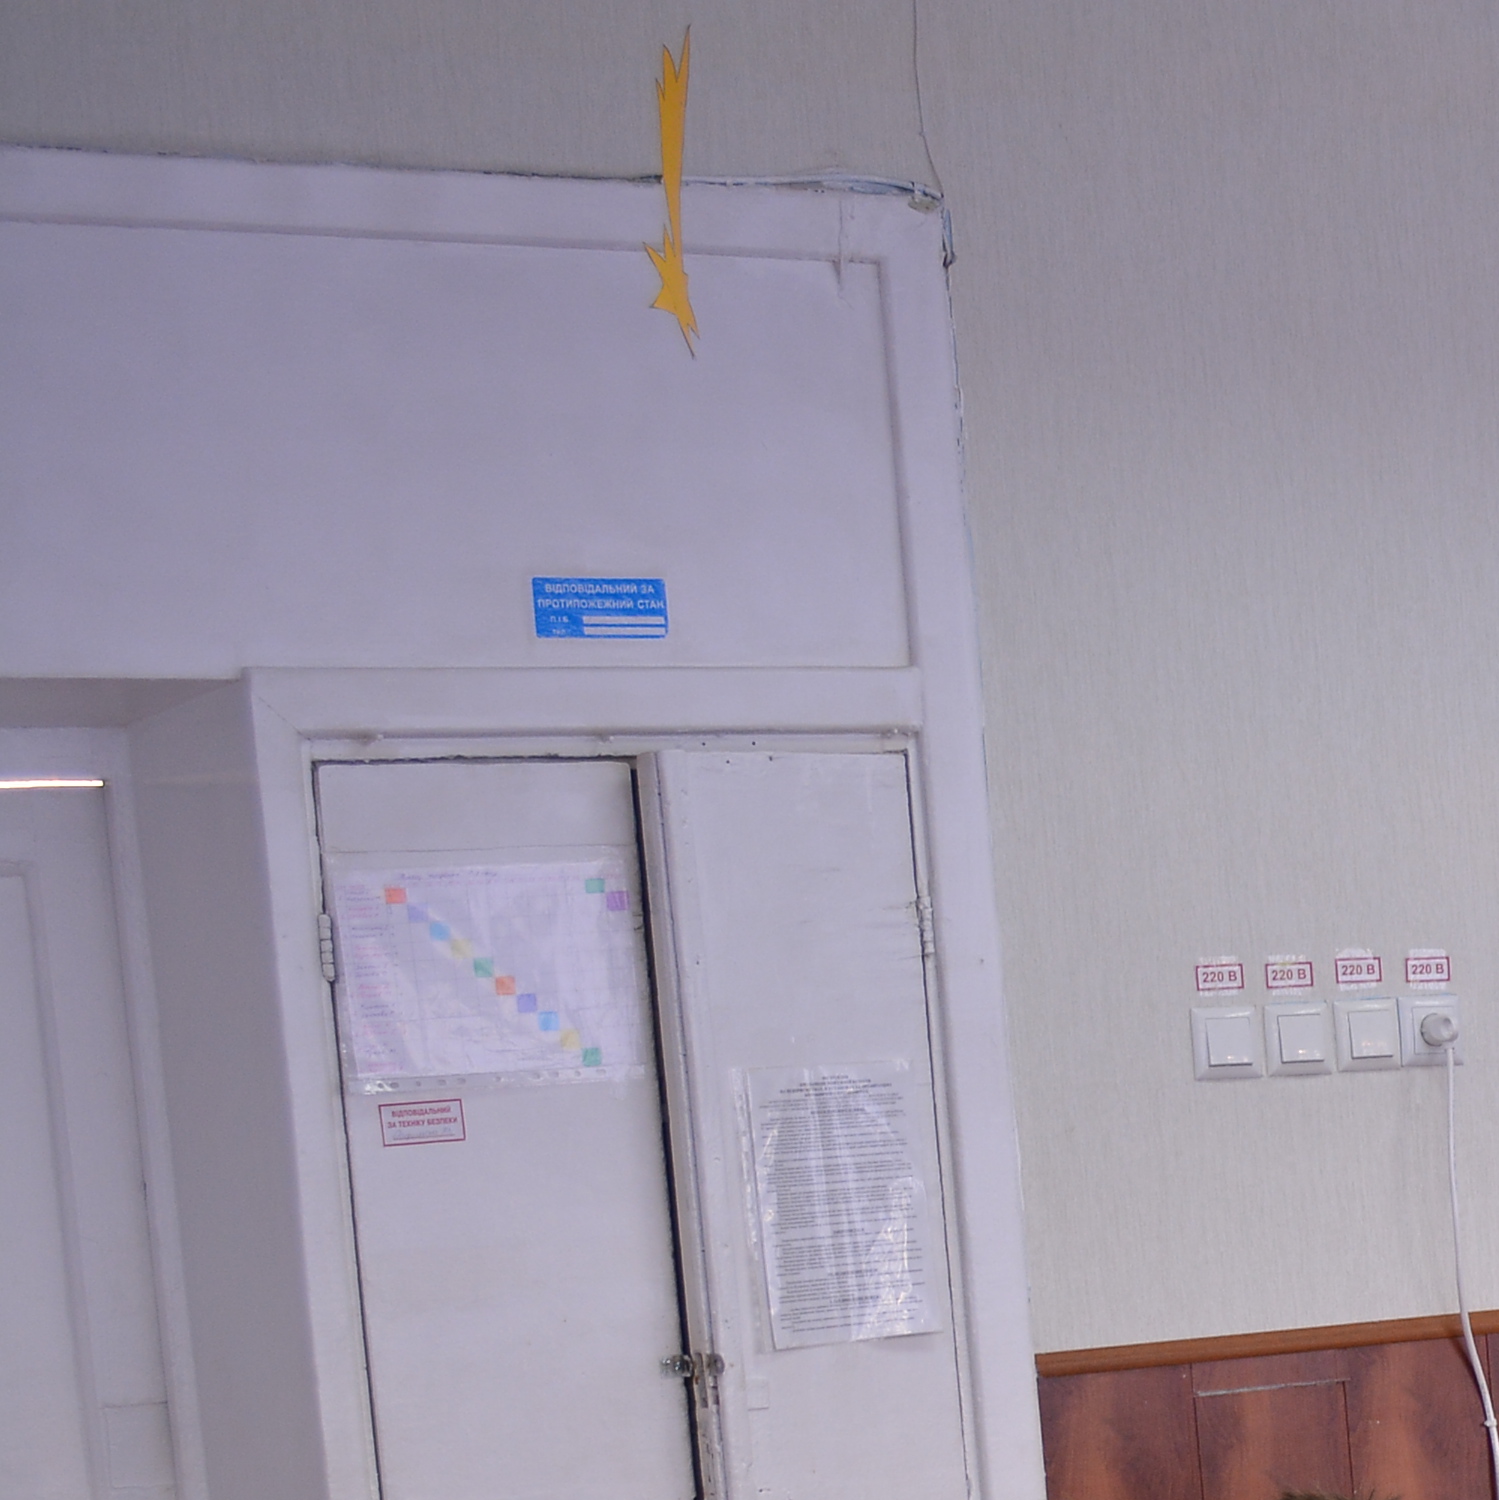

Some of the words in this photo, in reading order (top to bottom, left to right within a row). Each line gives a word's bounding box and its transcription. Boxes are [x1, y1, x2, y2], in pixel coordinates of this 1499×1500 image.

[545, 583, 638, 594] ВІДПОВІДАЛЬНИЙ
[640, 584, 655, 594] ЗА
[537, 599, 635, 609] ПРОТИПОЖЕЖНИЙ
[637, 600, 665, 609] СТАН
[1271, 970, 1293, 981] 220
[1297, 969, 1307, 980] В
[1341, 965, 1363, 976] 220
[1366, 964, 1376, 975] В
[1411, 964, 1433, 975] 220
[1435, 963, 1445, 974] В
[1202, 971, 1224, 983] 220
[1228, 971, 1238, 982] В
